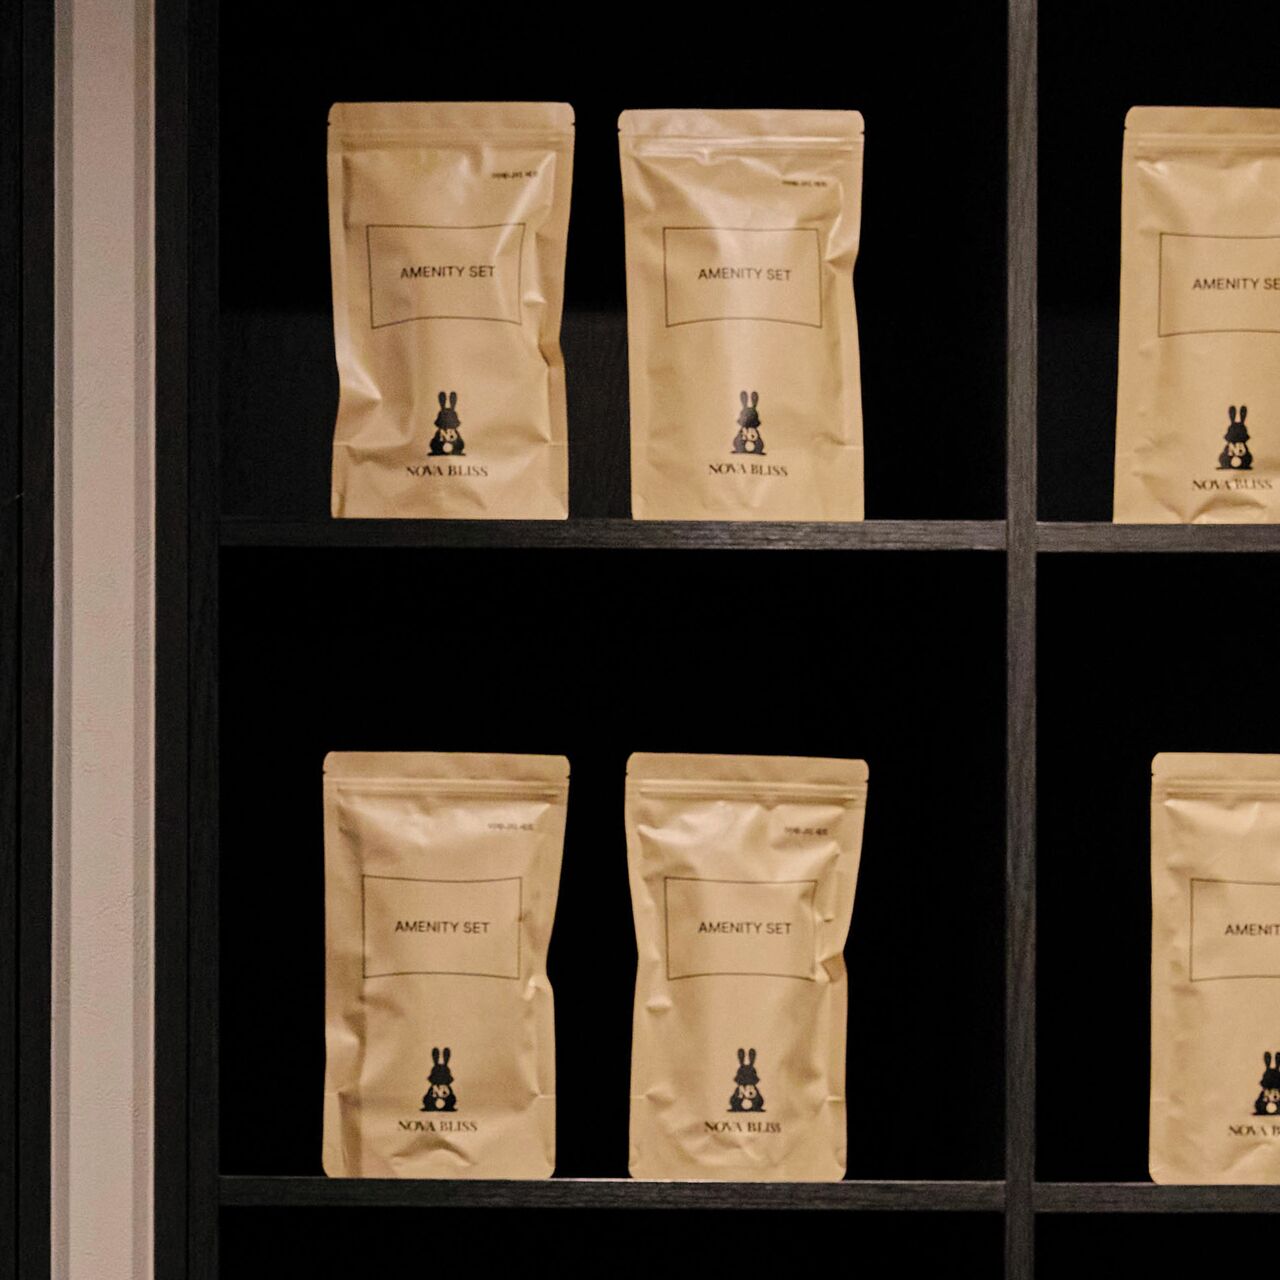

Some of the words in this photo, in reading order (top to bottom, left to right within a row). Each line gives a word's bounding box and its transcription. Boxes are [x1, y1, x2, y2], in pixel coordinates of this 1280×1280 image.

[400, 265, 464, 280] AMENITY
[470, 265, 496, 279] SET
[698, 267, 763, 281] AMENITY
[766, 268, 792, 281] SET
[1192, 278, 1260, 290] AMENITY
[1263, 278, 1280, 290] SE
[406, 465, 444, 477] NOVA
[448, 464, 489, 477] BLISS
[709, 463, 748, 476] NOVA
[751, 463, 788, 477] BLISS
[1192, 480, 1231, 490] NOVA
[1234, 480, 1273, 490] BLISS
[394, 920, 459, 933] AMENITY
[463, 920, 491, 933] SET
[698, 921, 763, 934] AMENITY
[766, 921, 792, 934] SET
[1225, 924, 1280, 935] AMENIT
[397, 1120, 436, 1132] NOVA
[440, 1120, 478, 1132] BLISS
[703, 1121, 744, 1133] NOVA
[747, 1122, 781, 1133] BLISS
